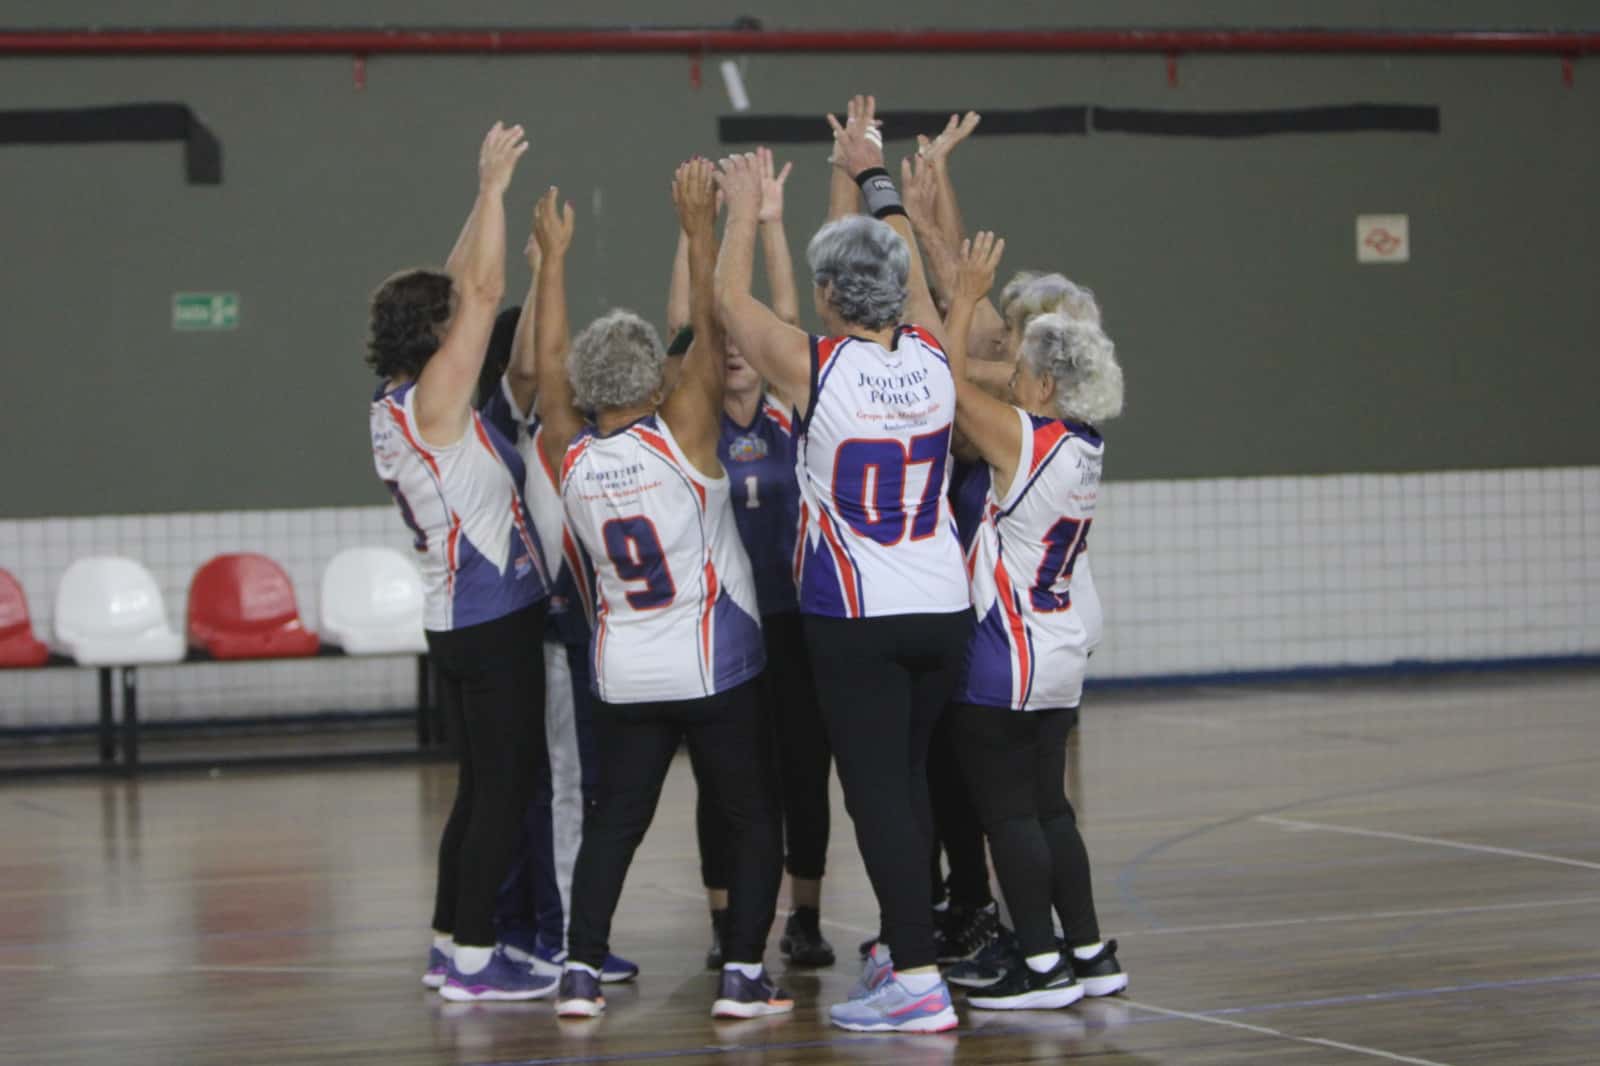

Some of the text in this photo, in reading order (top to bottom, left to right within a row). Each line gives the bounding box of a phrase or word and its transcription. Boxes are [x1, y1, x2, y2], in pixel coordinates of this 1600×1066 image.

[744, 476, 760, 509] 1
[831, 421, 951, 547] 07
[602, 514, 677, 612] 9
